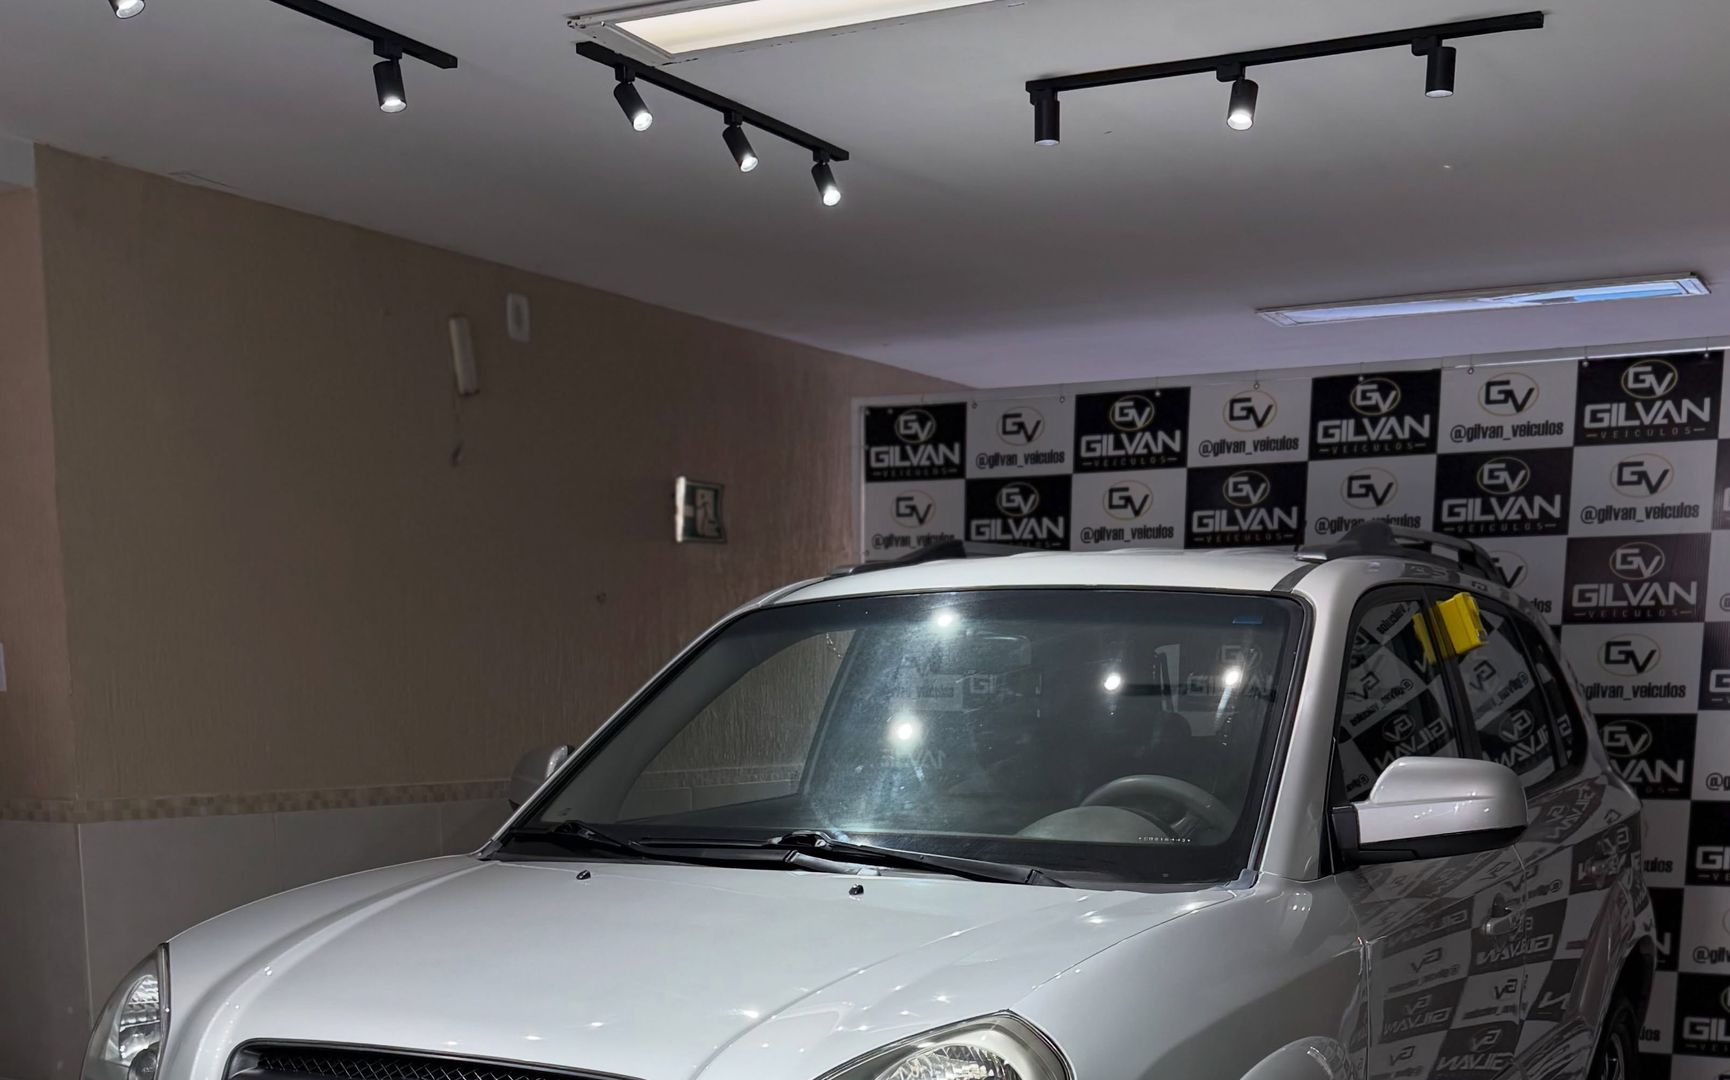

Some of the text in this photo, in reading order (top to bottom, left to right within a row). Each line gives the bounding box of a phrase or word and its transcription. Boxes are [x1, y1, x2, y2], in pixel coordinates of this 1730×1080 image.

[1627, 366, 1673, 396] GV
[1355, 383, 1397, 412] GV
[1485, 380, 1535, 413] GV
[1002, 413, 1041, 442] GV
[1114, 401, 1151, 428] GV
[1229, 397, 1273, 429] GV
[1583, 397, 1711, 429] GILVAN
[900, 415, 932, 441] GV
[1317, 414, 1431, 444] GILVAN
[1450, 420, 1564, 443] @gilvan_veiculos
[870, 442, 960, 467] GILVAN
[1080, 429, 1181, 458] GILVAN
[1199, 435, 1299, 458] @gilvan_veiculos
[976, 449, 1065, 469] @gilvan_veiculos
[1228, 476, 1266, 504] GV
[1347, 475, 1394, 507] GV
[1483, 463, 1526, 491] GV
[1616, 461, 1670, 495] GV
[896, 496, 932, 525] GV
[1001, 488, 1036, 515] GV
[1108, 486, 1150, 517] GV
[1441, 494, 1562, 523] GILVAN
[1580, 502, 1700, 525] @gilvan_veiculos
[971, 516, 1064, 541] GILVAN
[1080, 524, 1174, 544] @gilvan_veiculos
[1192, 506, 1298, 533] GILVAN
[1615, 548, 1661, 578] GV
[1571, 581, 1697, 608] GILVAN
[1605, 640, 1657, 674] GV
[1581, 681, 1686, 700] gilvan_veiculos
[1603, 725, 1648, 754] GV
